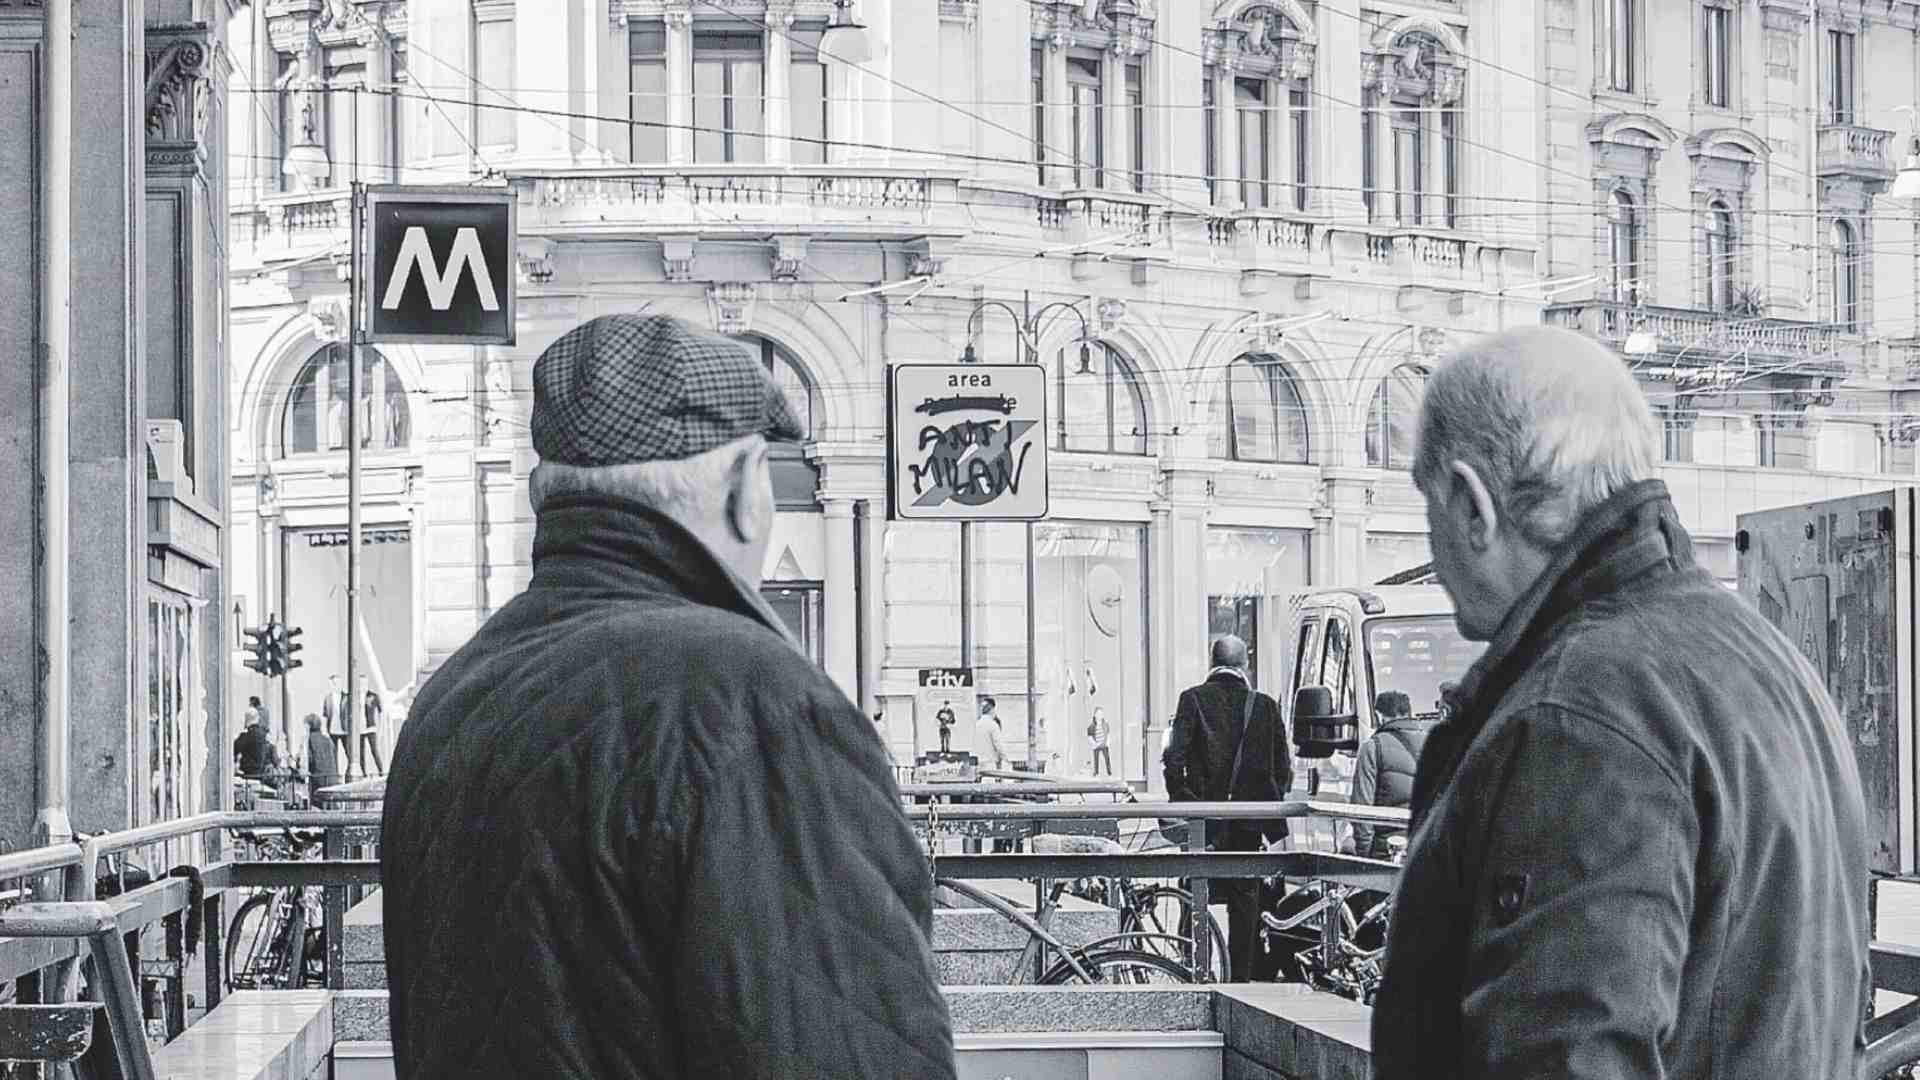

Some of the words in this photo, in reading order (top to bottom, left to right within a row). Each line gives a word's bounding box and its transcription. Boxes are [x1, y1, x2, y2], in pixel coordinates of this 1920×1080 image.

[381, 226, 500, 311] M
[948, 373, 992, 387] area
[918, 419, 1013, 451] ANTI
[908, 441, 1033, 495] MILAN
